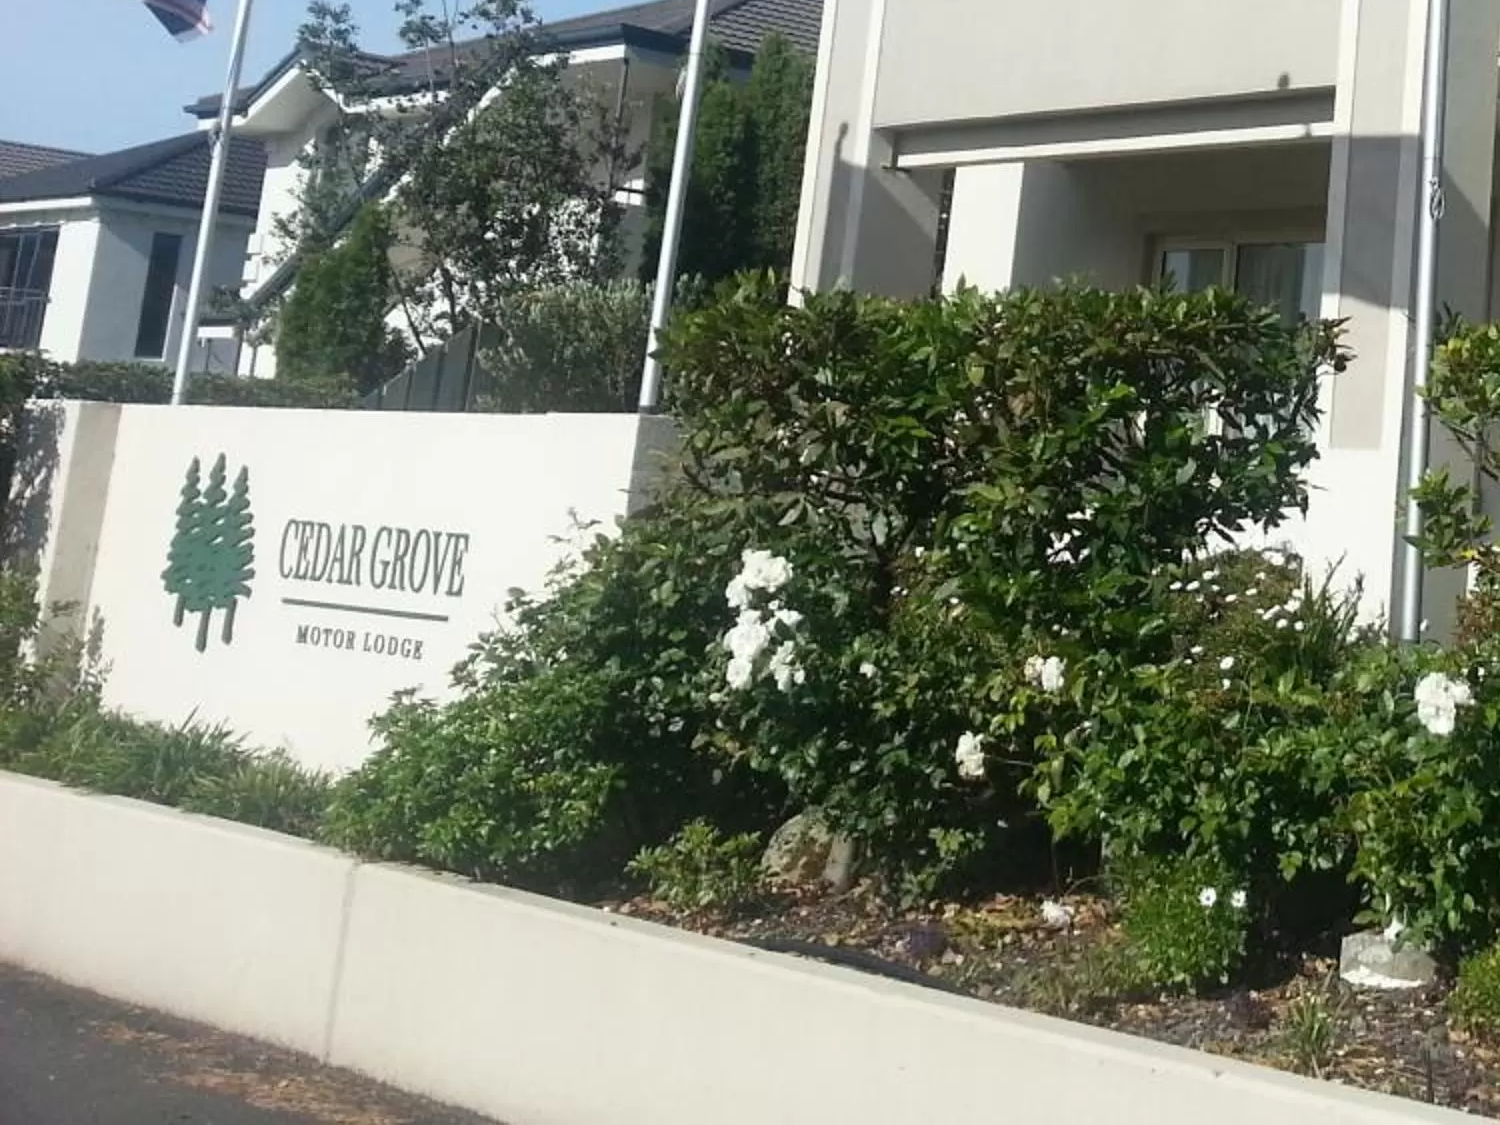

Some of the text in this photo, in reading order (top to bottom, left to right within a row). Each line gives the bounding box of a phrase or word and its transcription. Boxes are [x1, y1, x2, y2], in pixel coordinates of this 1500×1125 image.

[279, 518, 471, 598] CEDAR GROVE
[295, 624, 425, 661] MOTOR LODGE
